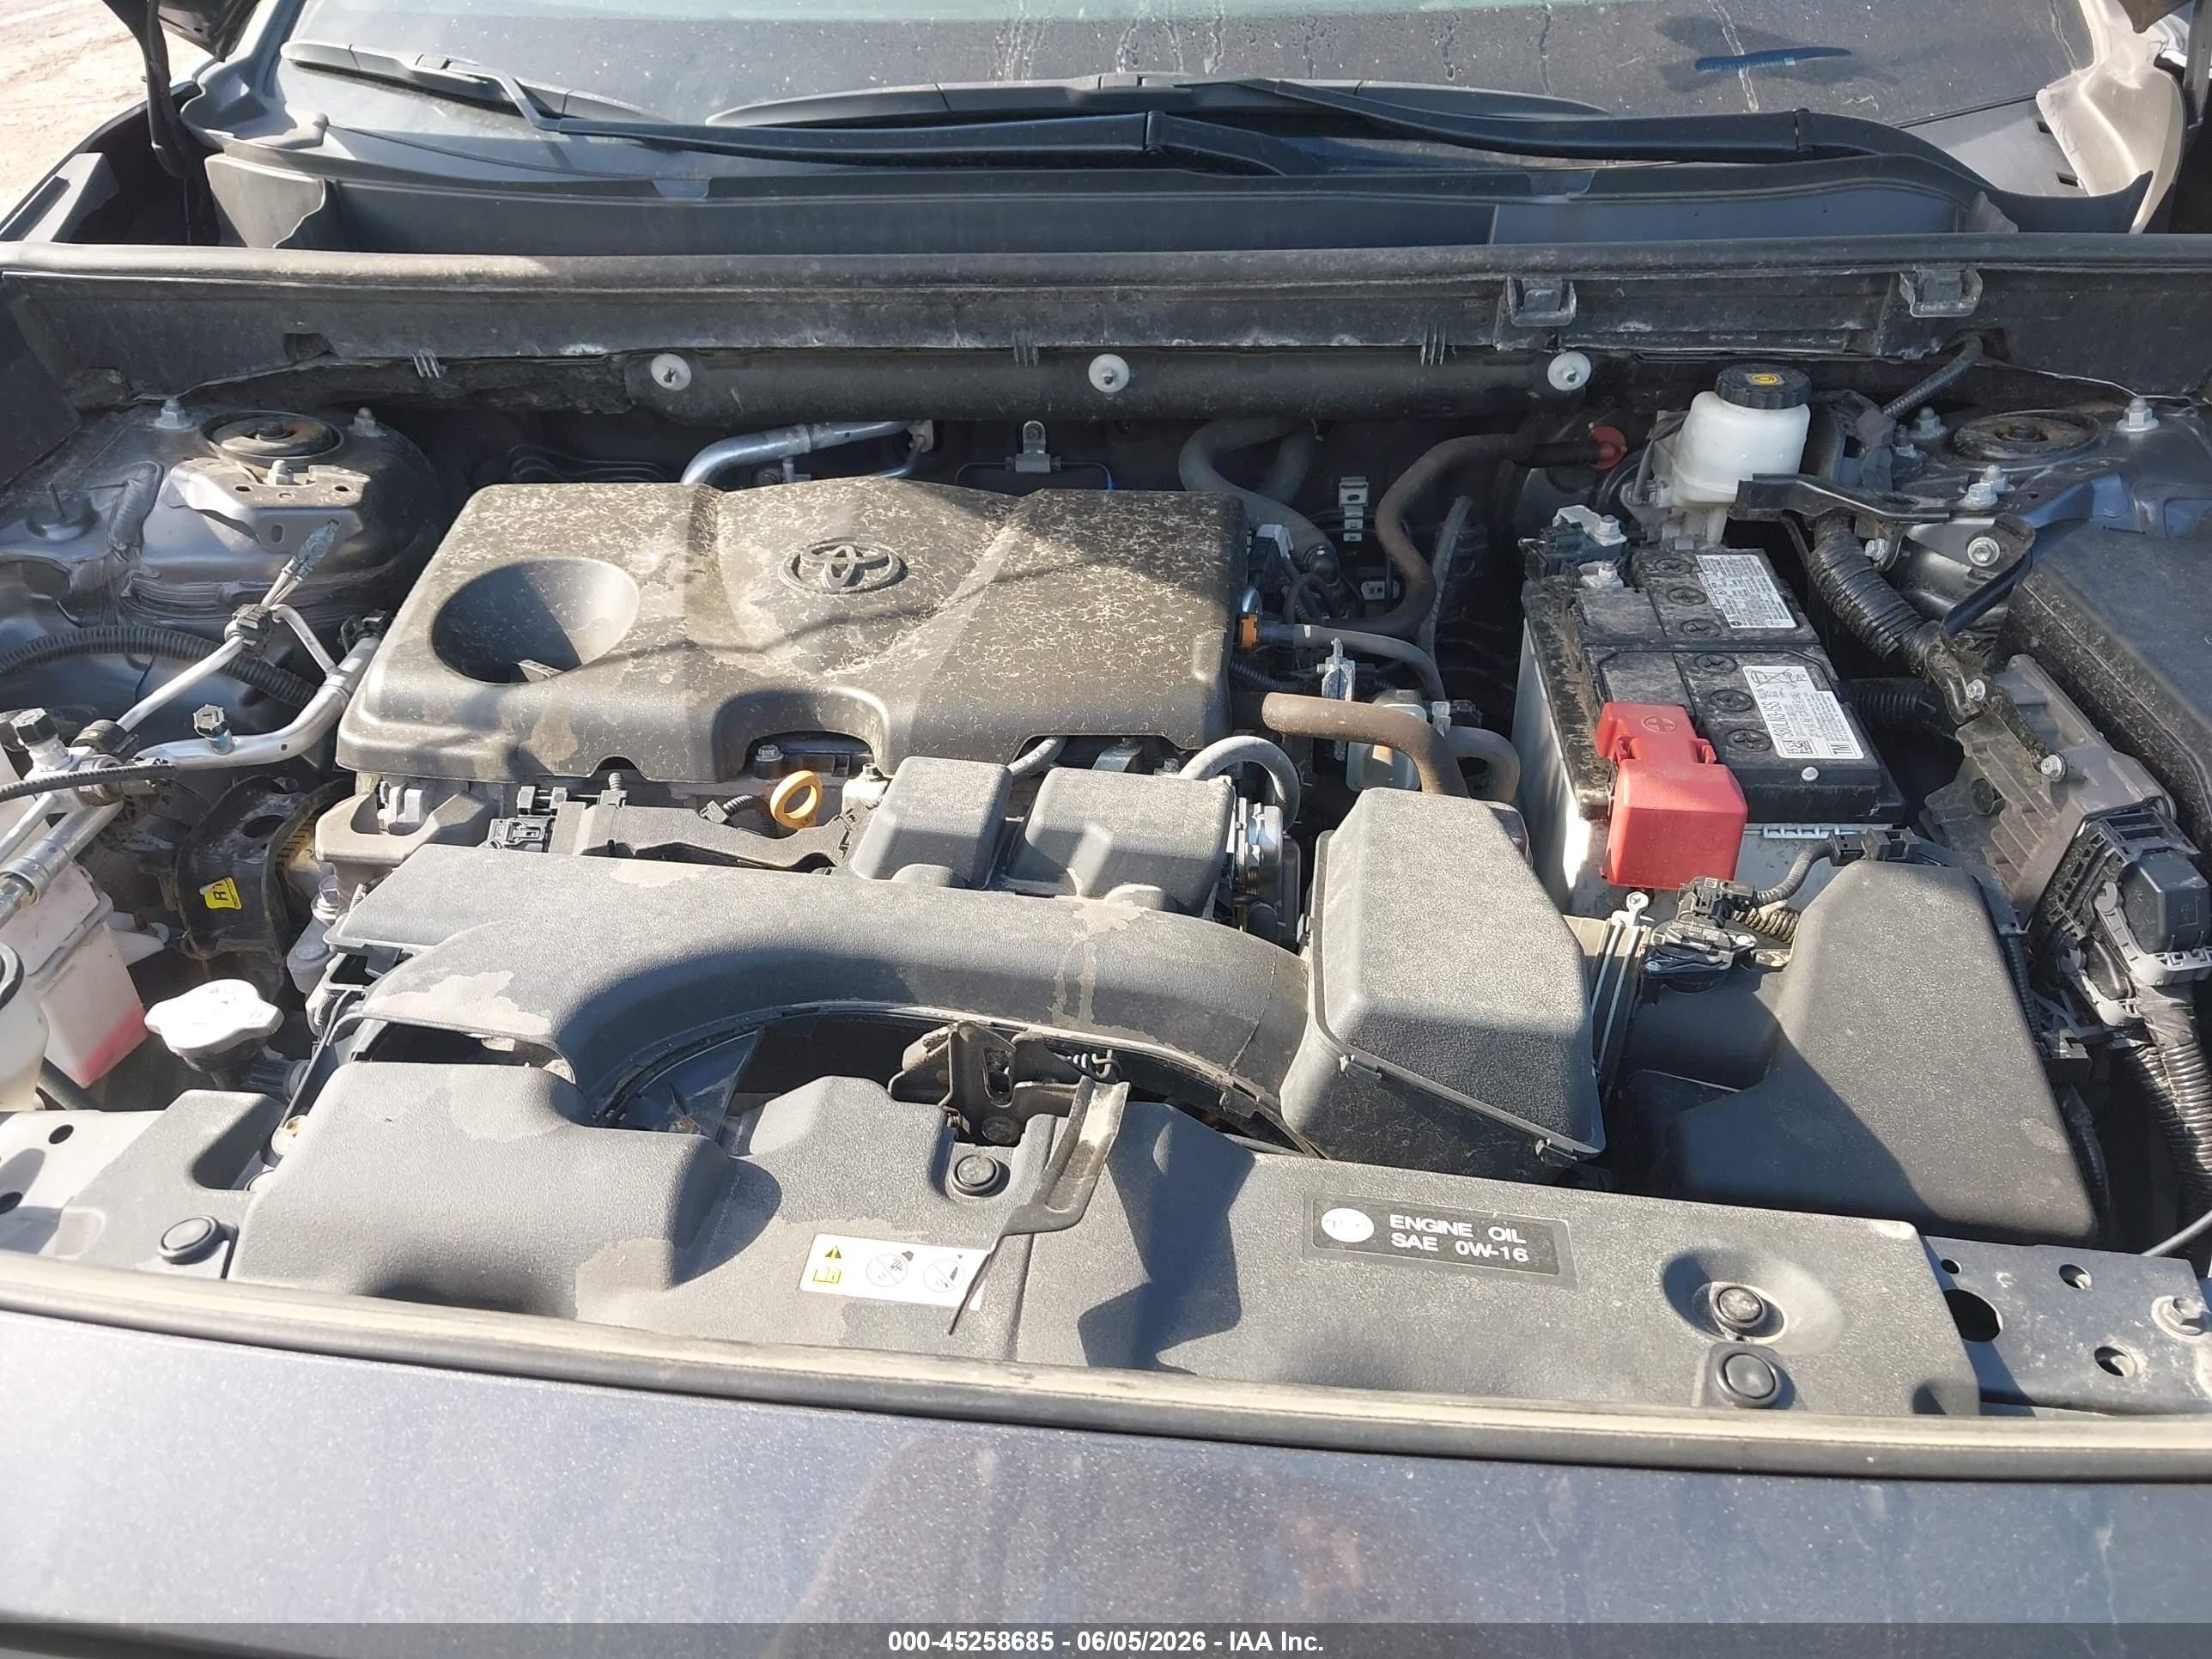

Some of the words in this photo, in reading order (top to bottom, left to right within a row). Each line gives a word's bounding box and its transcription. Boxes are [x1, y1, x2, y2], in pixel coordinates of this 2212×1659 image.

[1389, 1214, 1474, 1237] ENGINE
[1487, 1226, 1527, 1244] OIL
[1390, 1232, 1439, 1252] SAE
[1455, 1241, 1530, 1262] 0W-16
